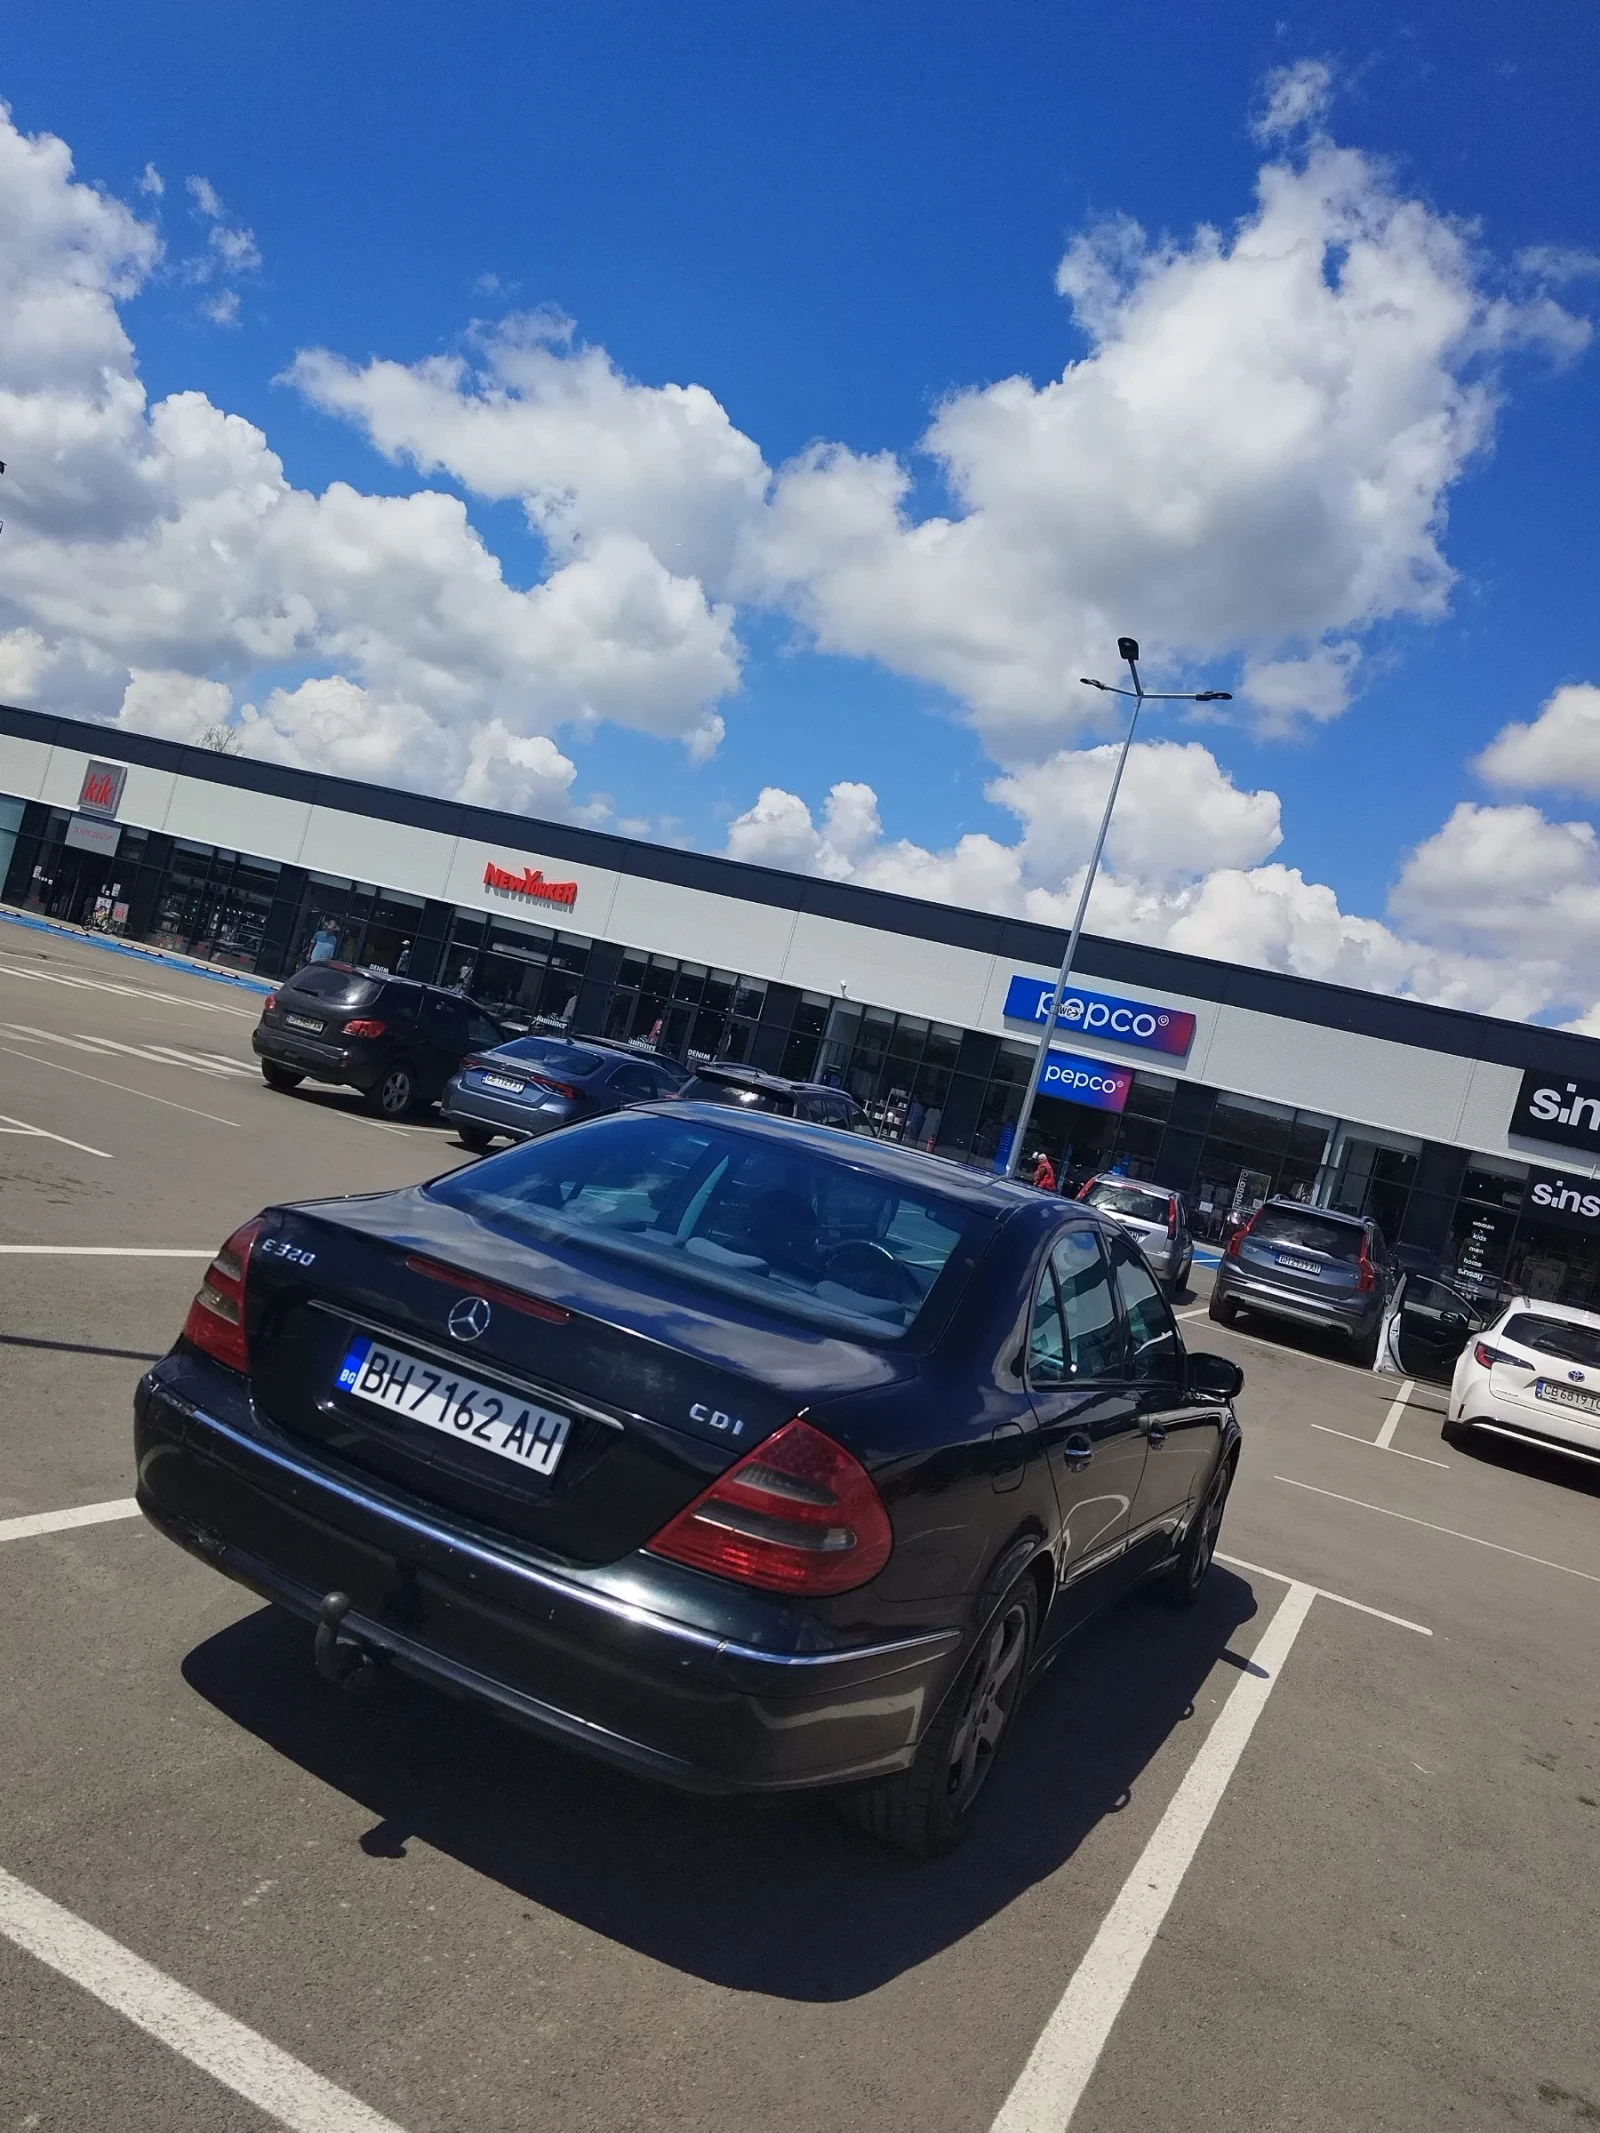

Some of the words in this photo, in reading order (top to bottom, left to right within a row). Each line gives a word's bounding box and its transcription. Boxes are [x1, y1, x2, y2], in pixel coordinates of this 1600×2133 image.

[688, 1049, 710, 1061] DENIM
[1045, 1065, 1117, 1094] pepco
[1472, 1221, 1495, 1231] woman
[1472, 1233, 1487, 1242] kids
[1468, 1246, 1484, 1255] men
[1463, 1257, 1483, 1268] home
[339, 1368, 356, 1385] BG
[689, 1402, 744, 1436] CDI
